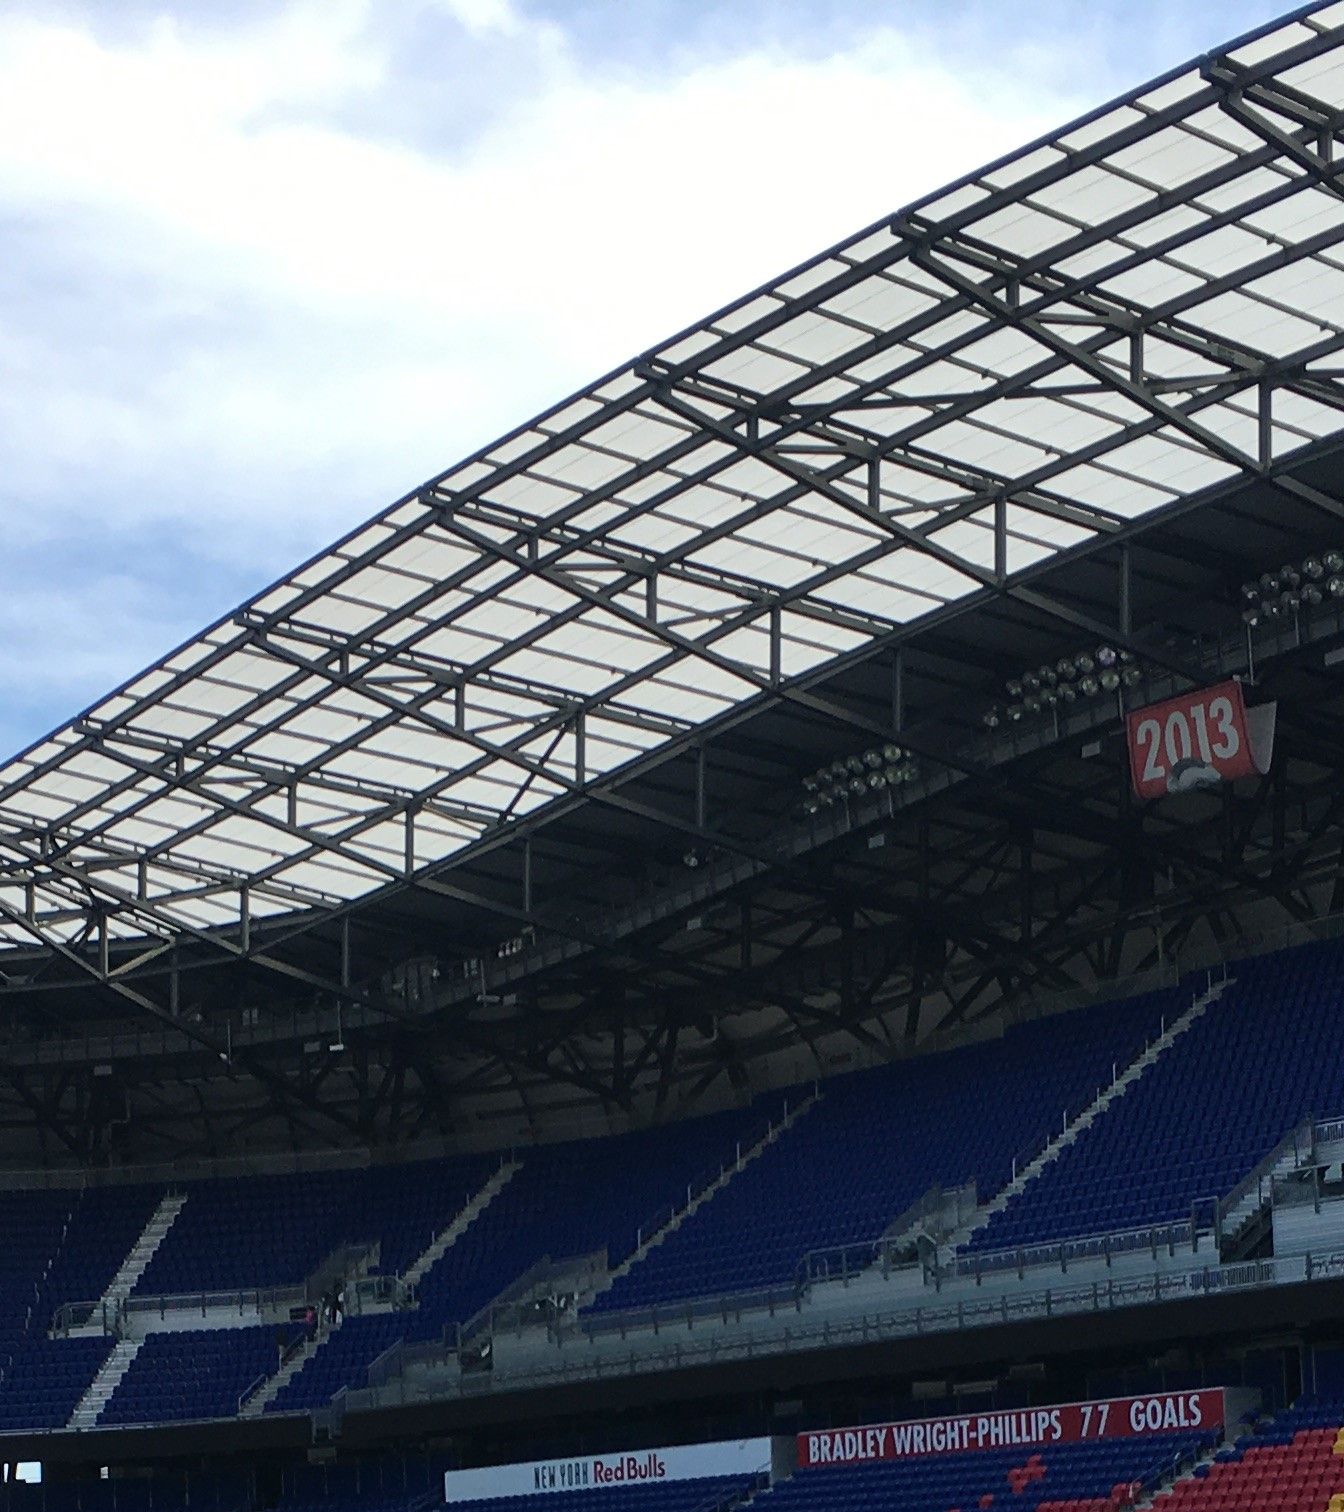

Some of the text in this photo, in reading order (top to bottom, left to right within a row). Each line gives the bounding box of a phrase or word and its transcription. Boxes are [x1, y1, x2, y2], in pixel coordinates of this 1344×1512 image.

[1136, 696, 1240, 782] 2013
[808, 1428, 888, 1464] BRADLEY
[892, 1410, 1061, 1455] WRIGHT-PHILLIPS
[1129, 1394, 1203, 1432] GOALS
[534, 1466, 556, 1489] NEW
[560, 1461, 589, 1486] YORK
